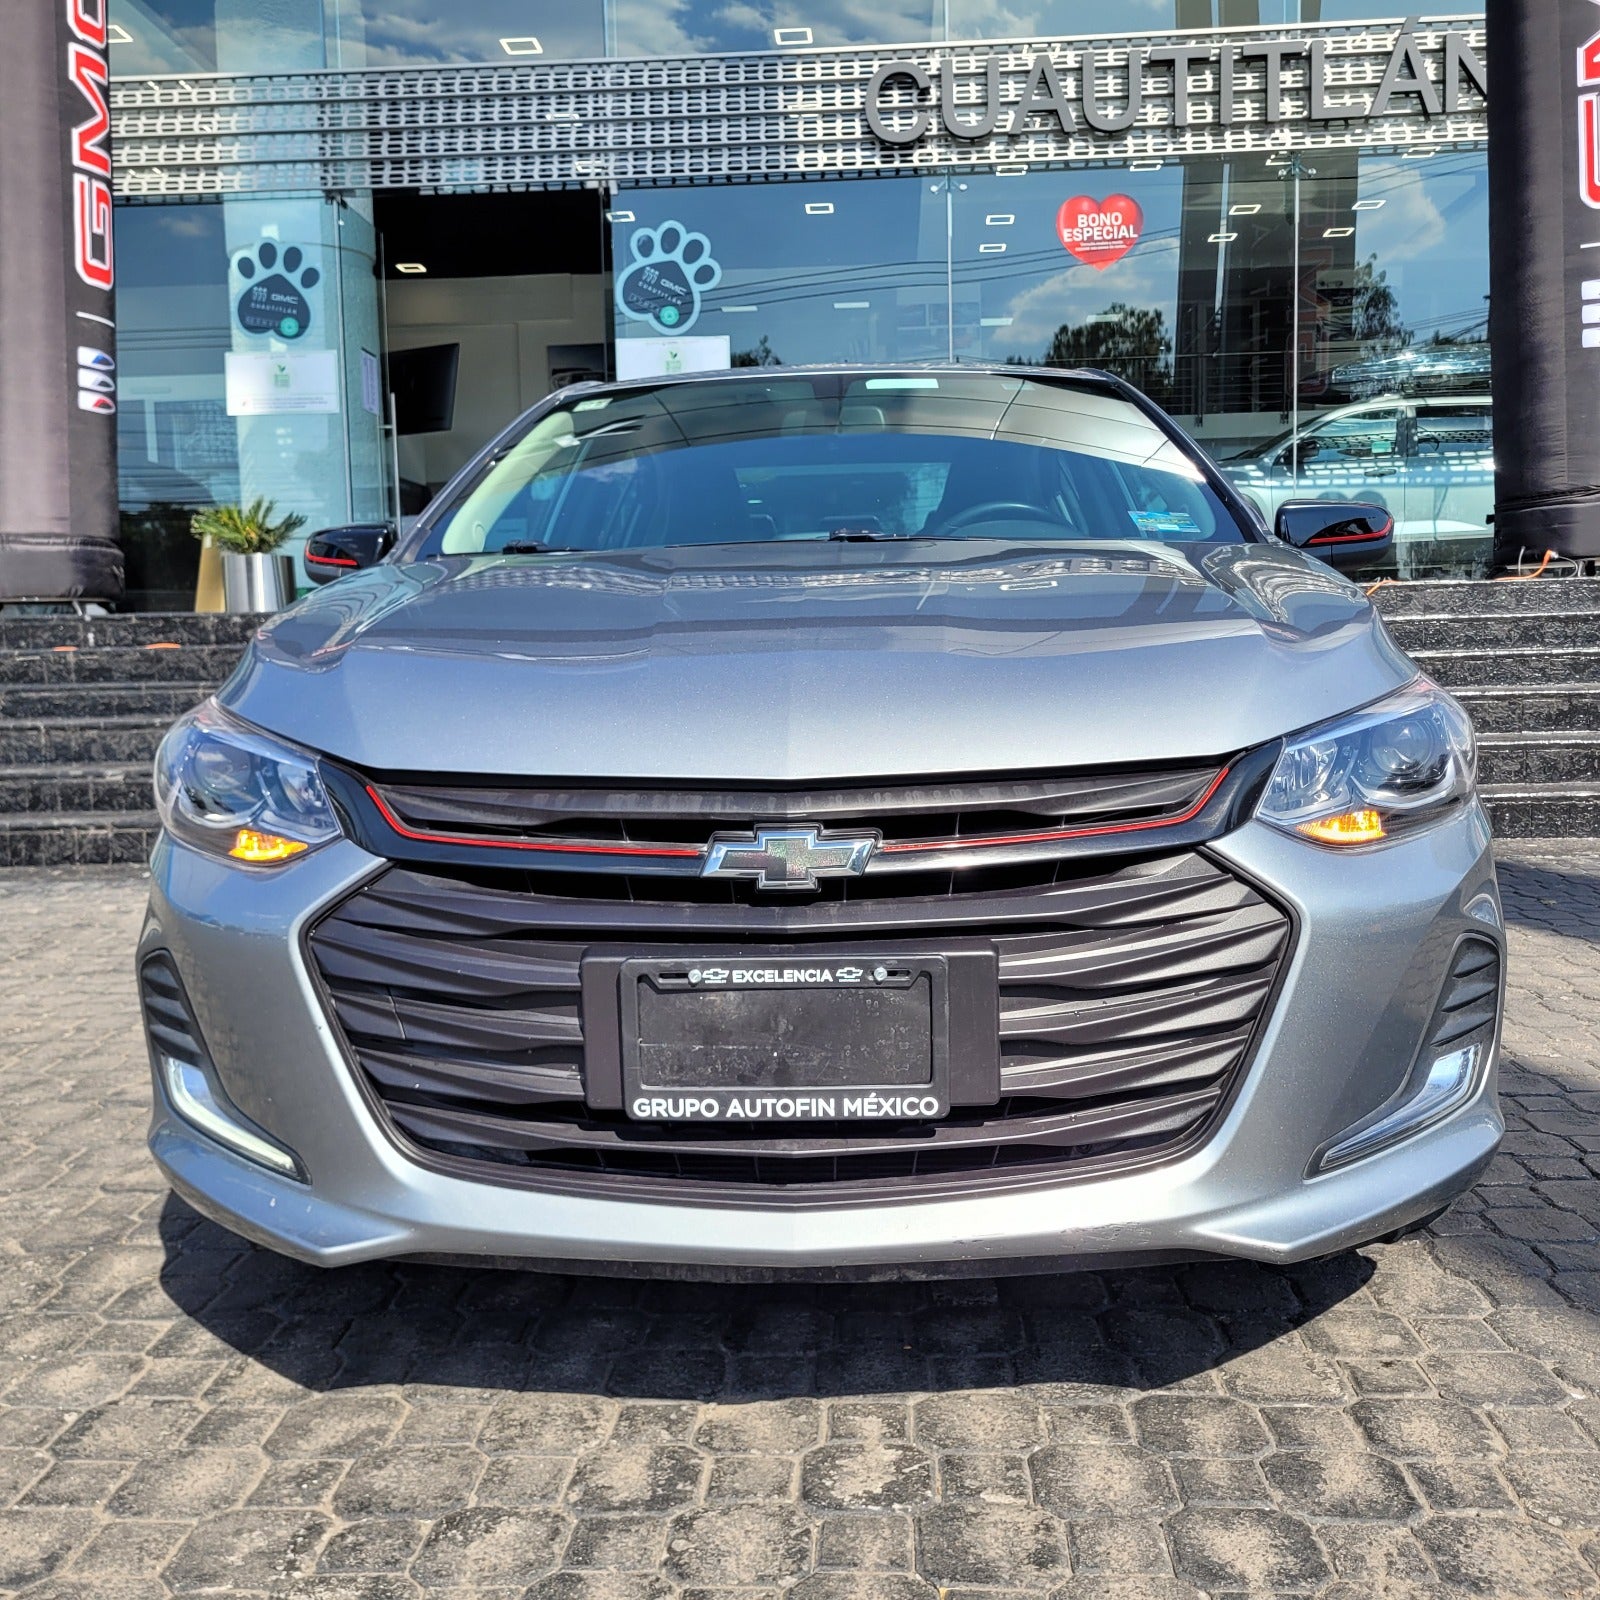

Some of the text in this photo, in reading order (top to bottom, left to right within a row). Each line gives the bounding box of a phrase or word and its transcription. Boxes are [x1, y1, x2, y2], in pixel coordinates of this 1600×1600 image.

[864, 16, 1487, 144] CUAUTITLÁN
[1077, 211, 1123, 228] BONO
[1062, 224, 1139, 243] ESPECIAL
[660, 278, 688, 296] GMC
[271, 293, 299, 305] GMC
[732, 968, 833, 983] EXCELENCIA
[633, 1092, 939, 1118] GRUPO AUTOFIN MÉXICO
